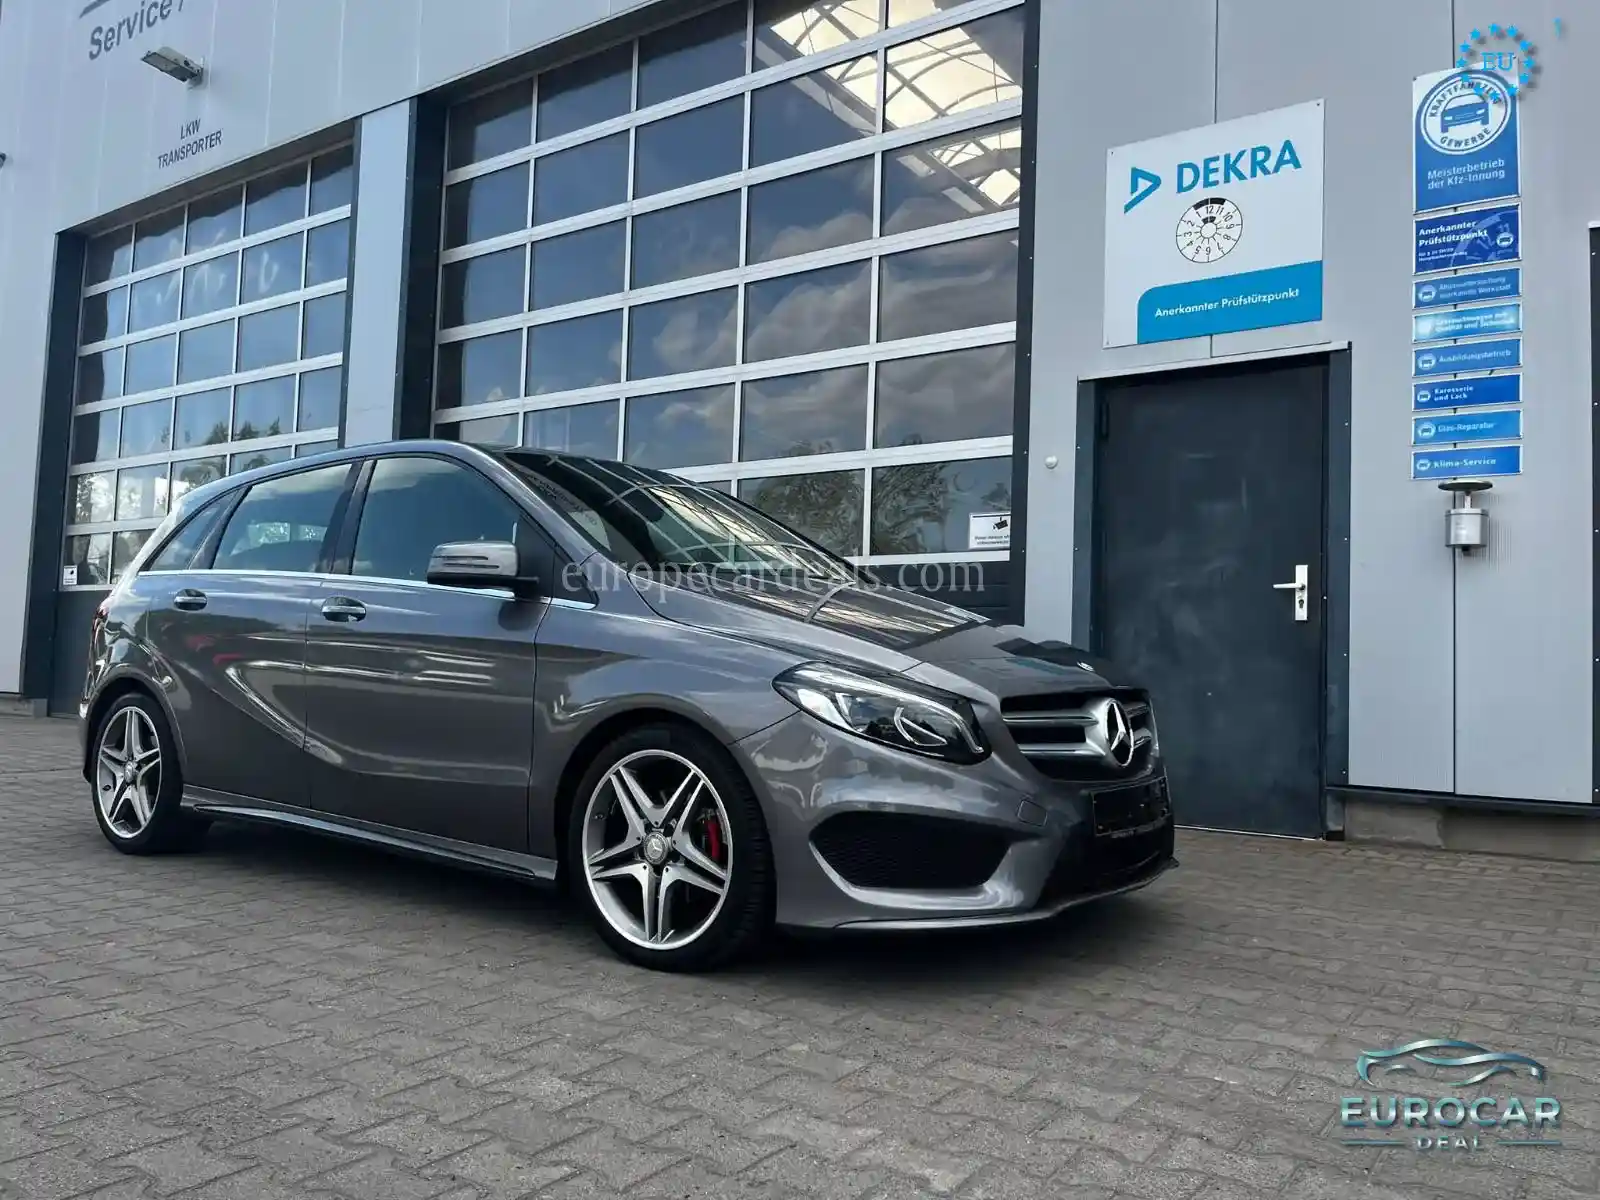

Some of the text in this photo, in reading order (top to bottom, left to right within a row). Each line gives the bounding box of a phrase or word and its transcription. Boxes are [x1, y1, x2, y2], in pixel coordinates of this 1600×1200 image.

[89, 0, 173, 60] Service
[180, 118, 201, 140] LKW
[1440, 127, 1491, 148] GEWERBE
[157, 130, 222, 169] TRANSPORTER
[1176, 139, 1302, 194] DEKRA
[1427, 158, 1505, 180] Meisterbetrieb
[1427, 169, 1506, 190] der Kfz-Innung
[1418, 220, 1477, 237] Anerkannter
[1418, 229, 1488, 247] Prüfstützpunkt
[1154, 287, 1300, 319] Anerkannter Prüfstützpunkt
[1434, 392, 1468, 402] und Lack
[1433, 456, 1497, 469] Klima-Service
